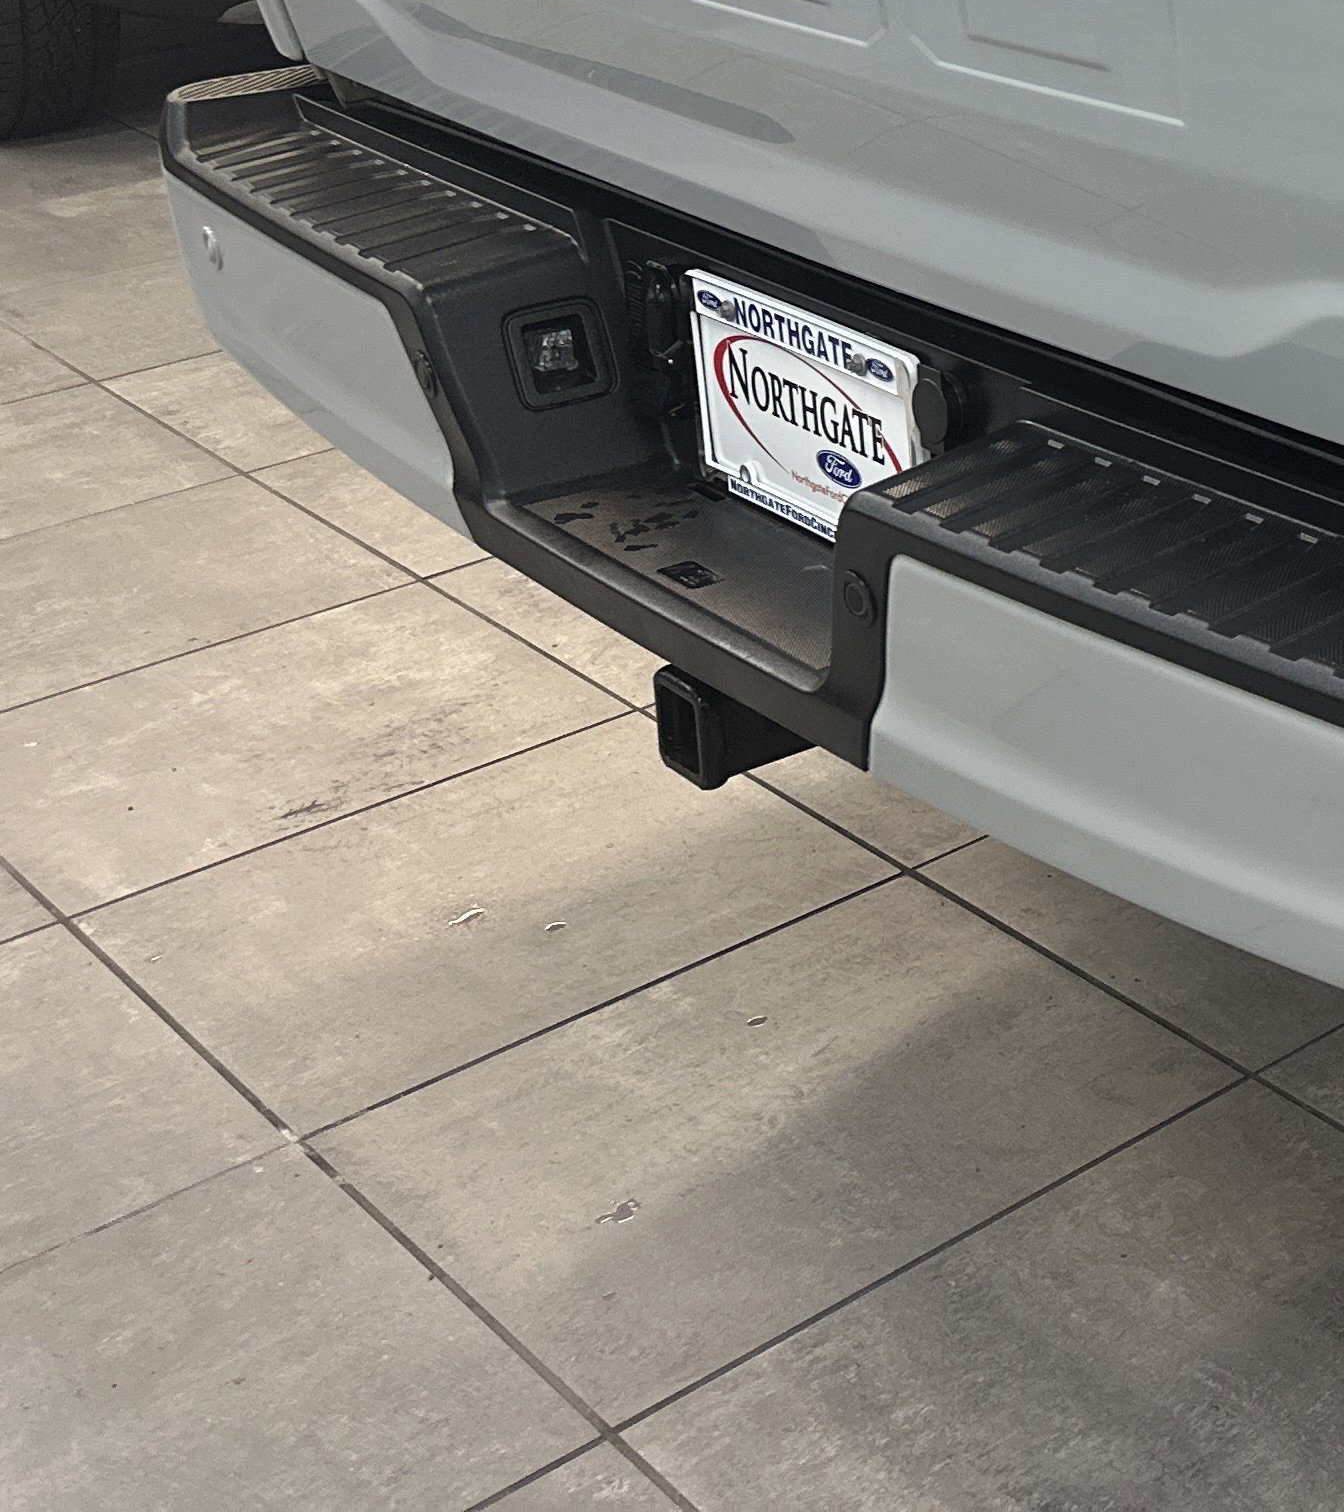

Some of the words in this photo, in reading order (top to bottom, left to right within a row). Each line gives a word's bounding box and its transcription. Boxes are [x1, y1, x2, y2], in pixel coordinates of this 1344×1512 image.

[733, 297, 854, 370] NORTHGATE
[727, 340, 886, 466] NORTHGATE
[824, 454, 854, 483] Ford
